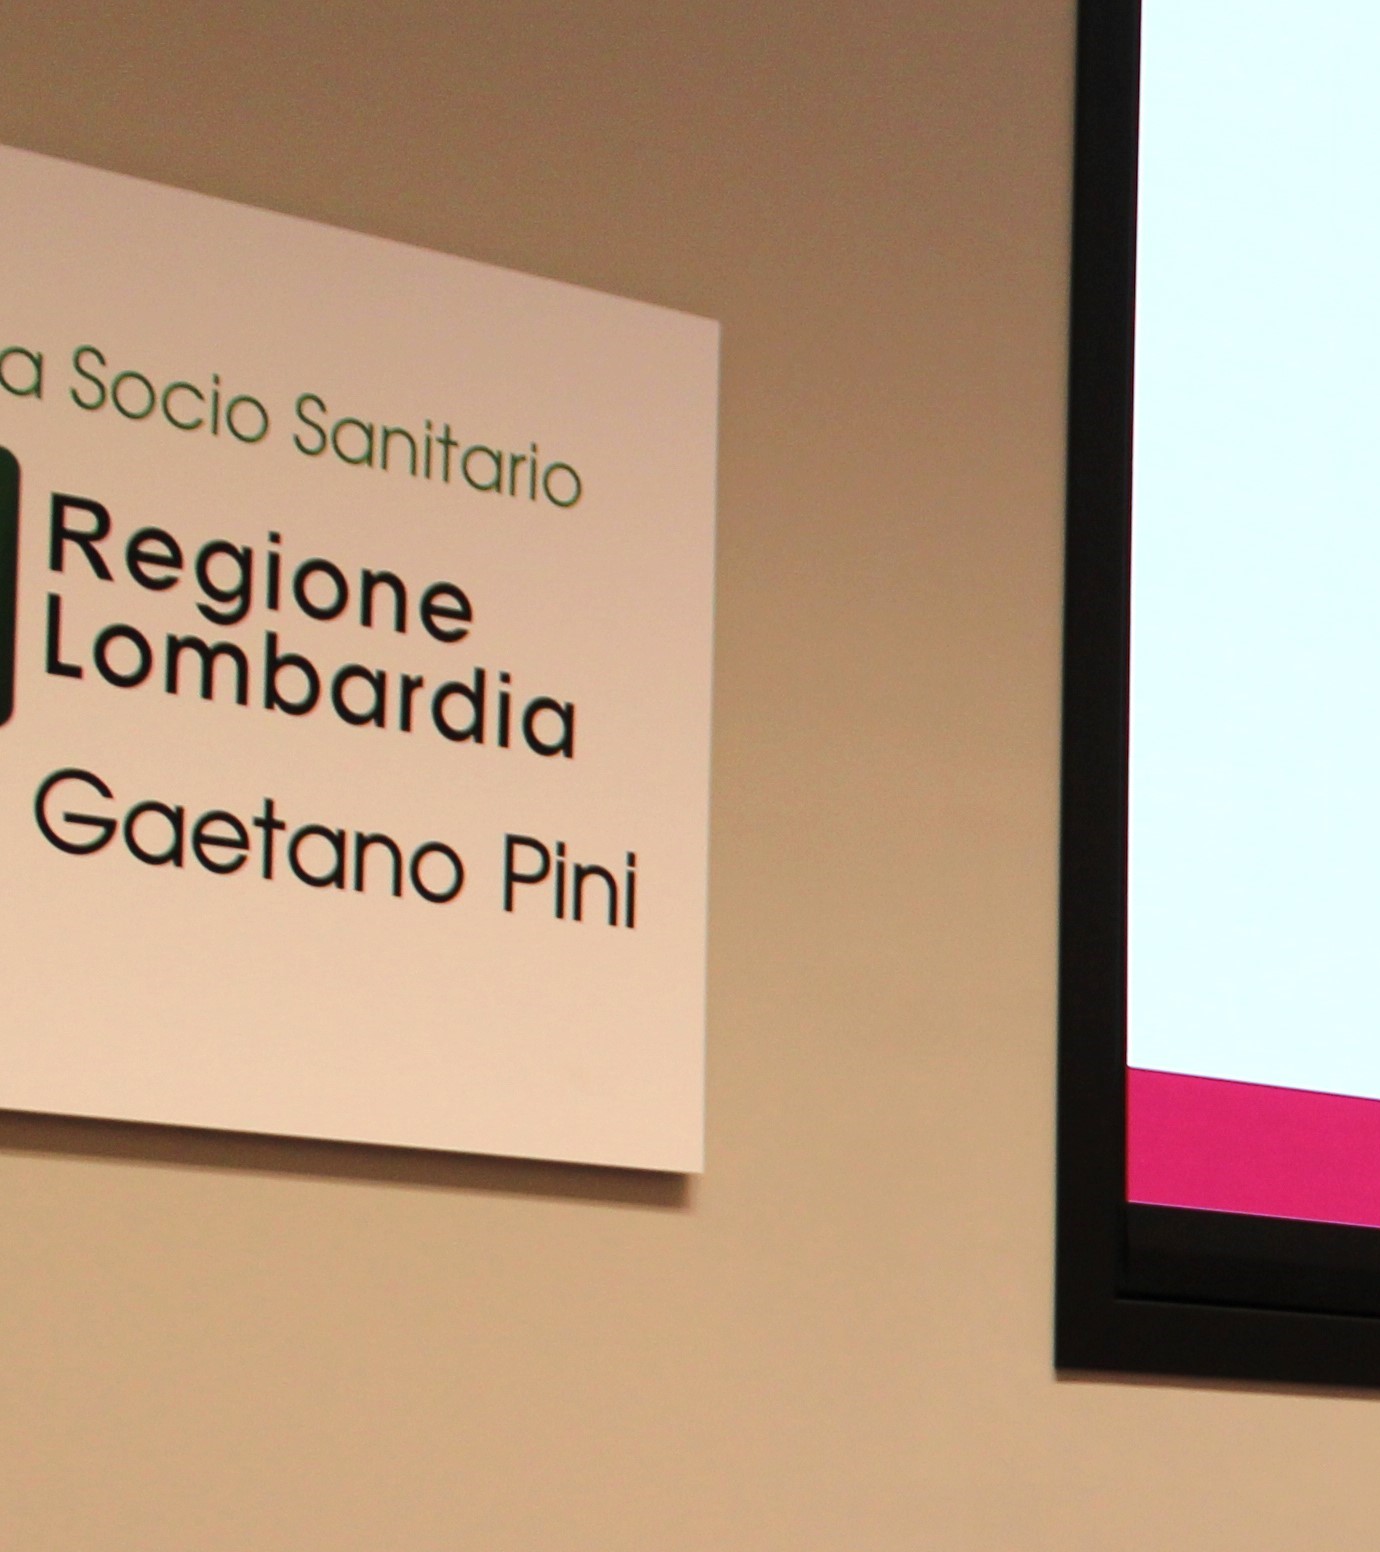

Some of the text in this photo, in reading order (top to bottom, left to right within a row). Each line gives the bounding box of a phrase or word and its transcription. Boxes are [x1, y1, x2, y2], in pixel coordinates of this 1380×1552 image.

[70, 347, 269, 443] Socio
[294, 393, 583, 507] Sanitario
[48, 493, 473, 644] Regione
[43, 594, 576, 758] Lombardia
[34, 769, 637, 929] Gaetano Pini
